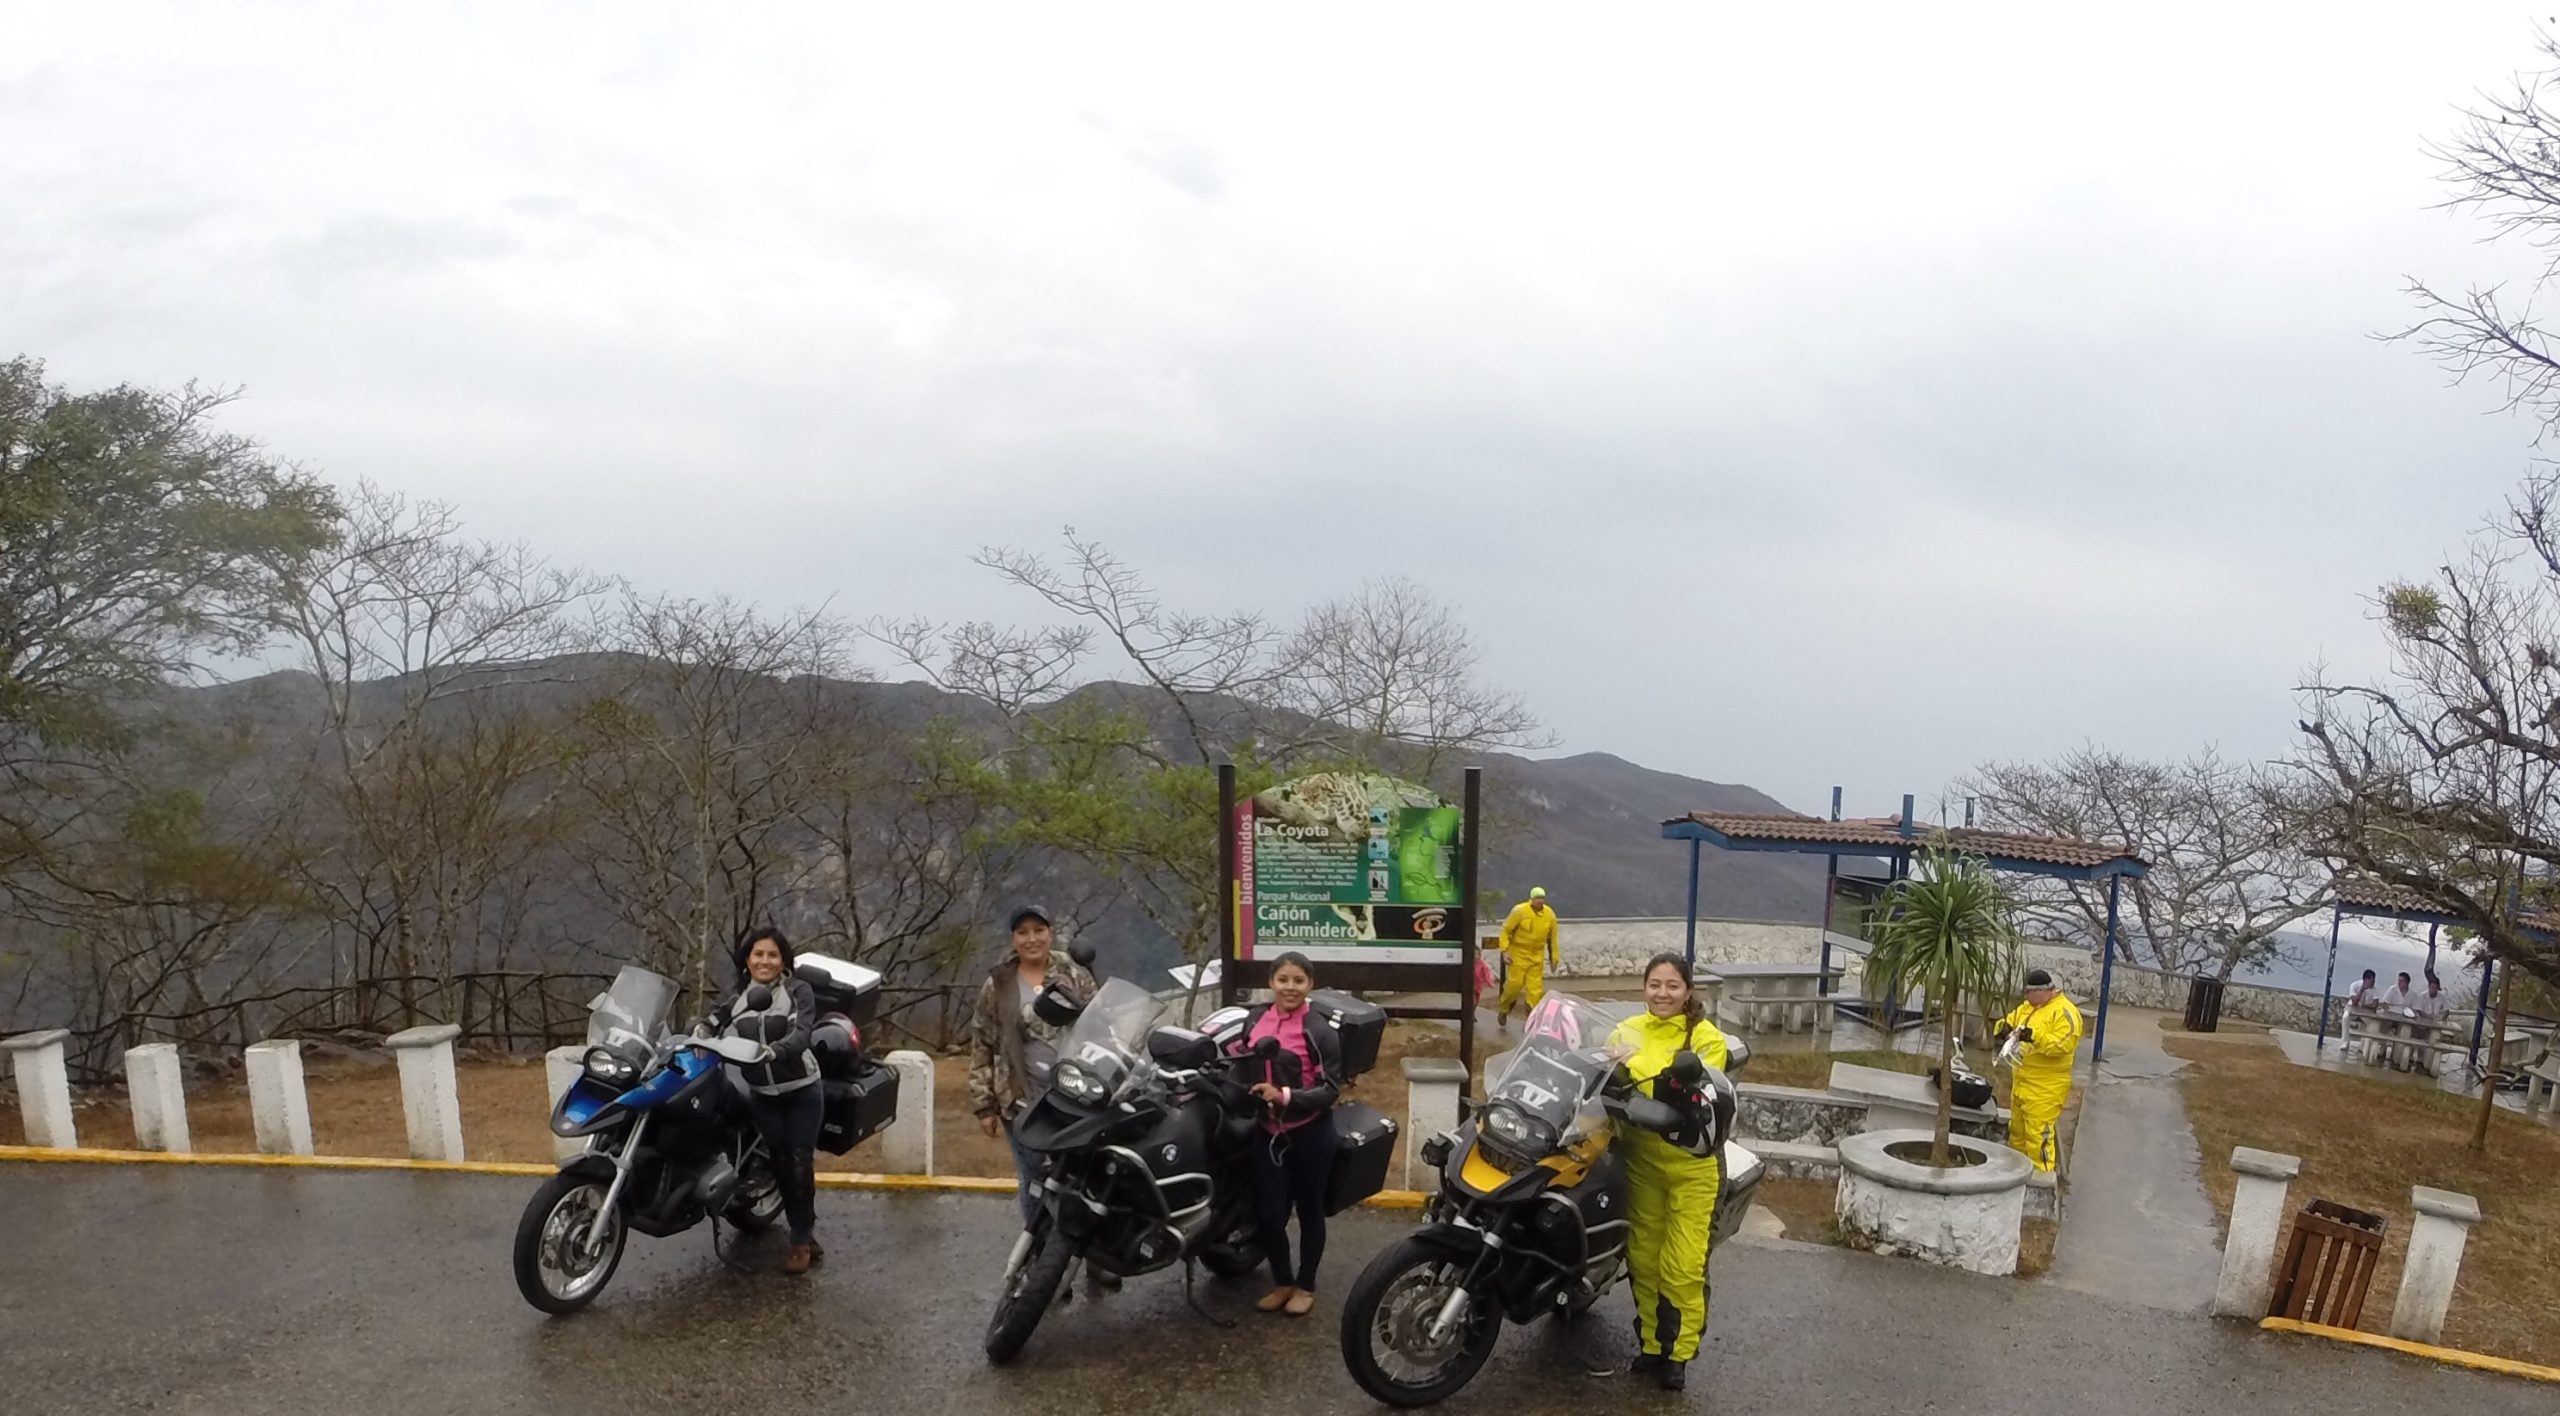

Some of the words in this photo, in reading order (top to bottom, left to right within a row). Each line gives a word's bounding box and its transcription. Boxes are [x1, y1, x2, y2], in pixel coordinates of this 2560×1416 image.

[1255, 821, 1273, 837] La
[1277, 823, 1329, 840] Coyota
[1238, 814, 1253, 905] bienvenidos
[1256, 890, 1289, 903] Parque
[1290, 891, 1331, 902] Nacional
[1257, 904, 1310, 921] Cañón
[1257, 925, 1276, 937] del
[1278, 921, 1358, 938] Sumidero
